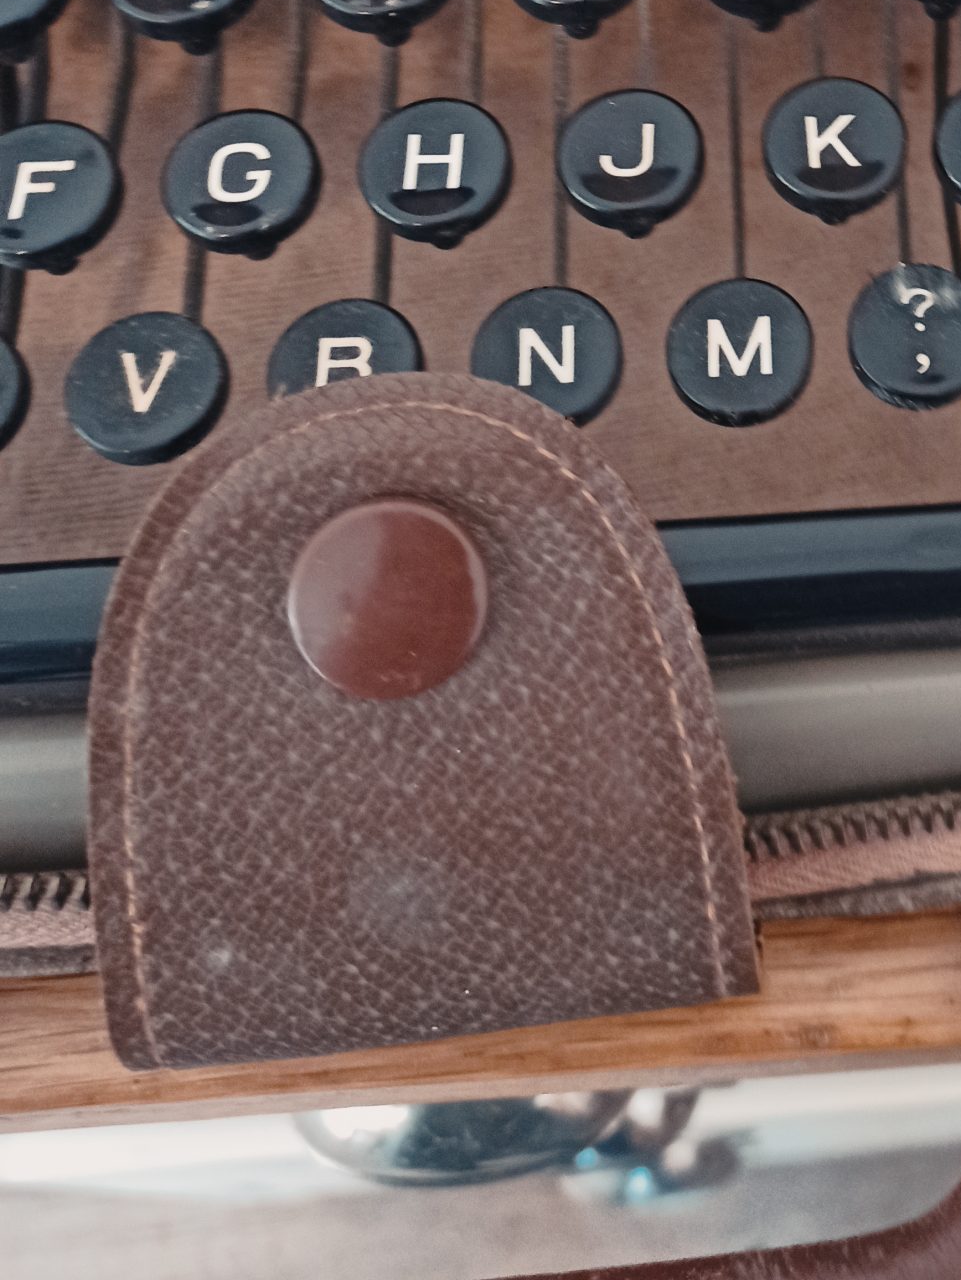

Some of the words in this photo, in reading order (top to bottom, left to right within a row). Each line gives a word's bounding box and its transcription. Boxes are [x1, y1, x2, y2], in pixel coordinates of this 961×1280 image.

[402, 133, 465, 190] H
[598, 123, 655, 178] J
[804, 114, 862, 169] K
[7, 159, 76, 220] F
[207, 142, 272, 203] G
[899, 286, 936, 333] ?
[314, 336, 373, 388] B
[518, 324, 575, 387] N
[706, 315, 773, 378] M
[120, 349, 178, 413] V
